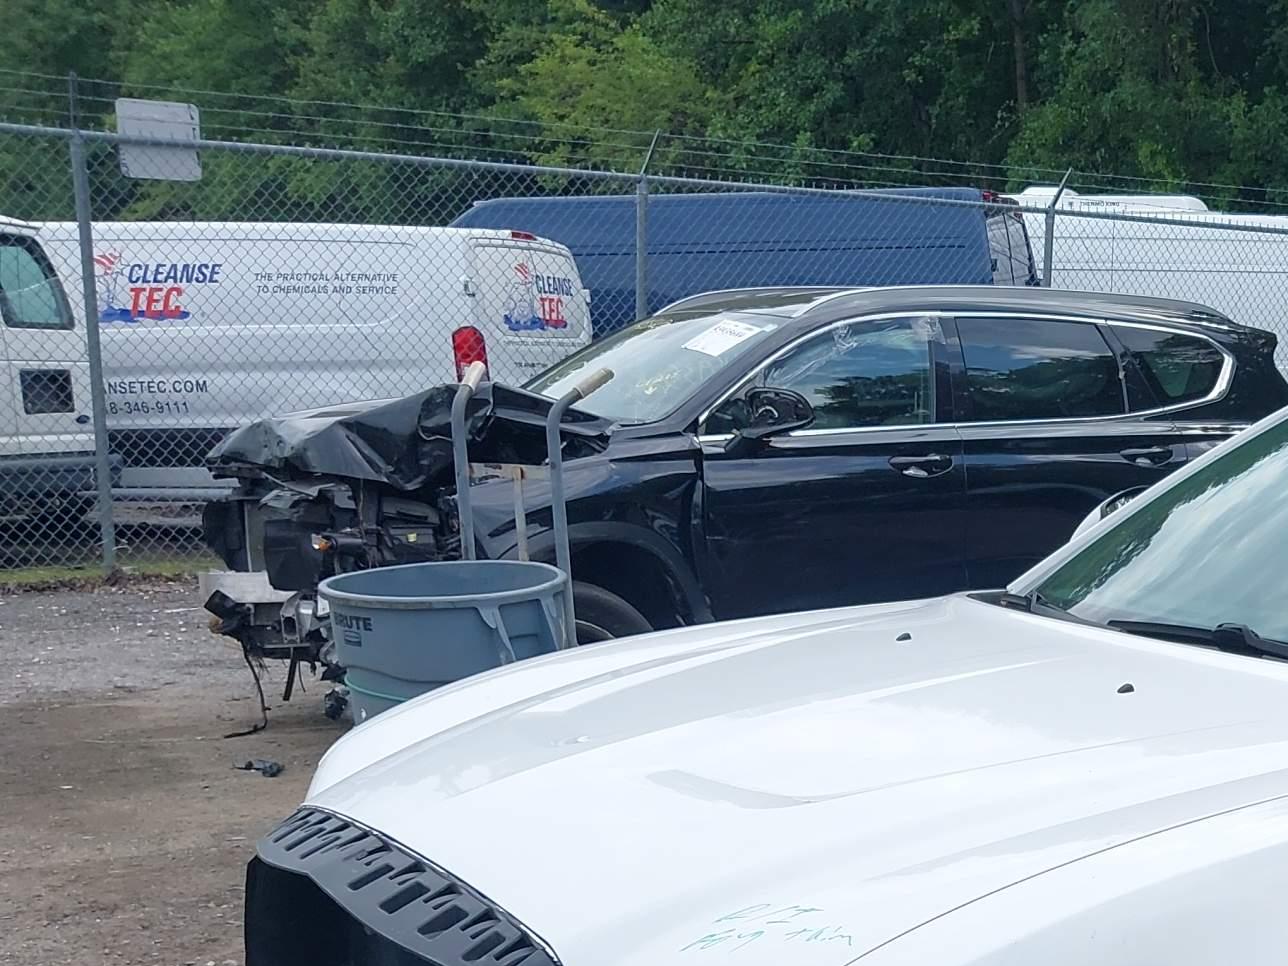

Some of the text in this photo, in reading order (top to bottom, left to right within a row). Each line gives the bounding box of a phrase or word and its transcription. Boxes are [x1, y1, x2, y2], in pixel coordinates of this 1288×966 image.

[127, 263, 222, 284] CLEANSE
[255, 272, 398, 282] THE PRACTICAL ALTERNATIVE
[257, 284, 398, 295] TO CHEMICALS AND SERVICE
[535, 274, 573, 297] CLEANSE
[129, 287, 184, 320] TEC
[540, 297, 566, 328] TEC
[103, 380, 208, 394] NSETEC.COM
[105, 401, 189, 415] 8-346-9111
